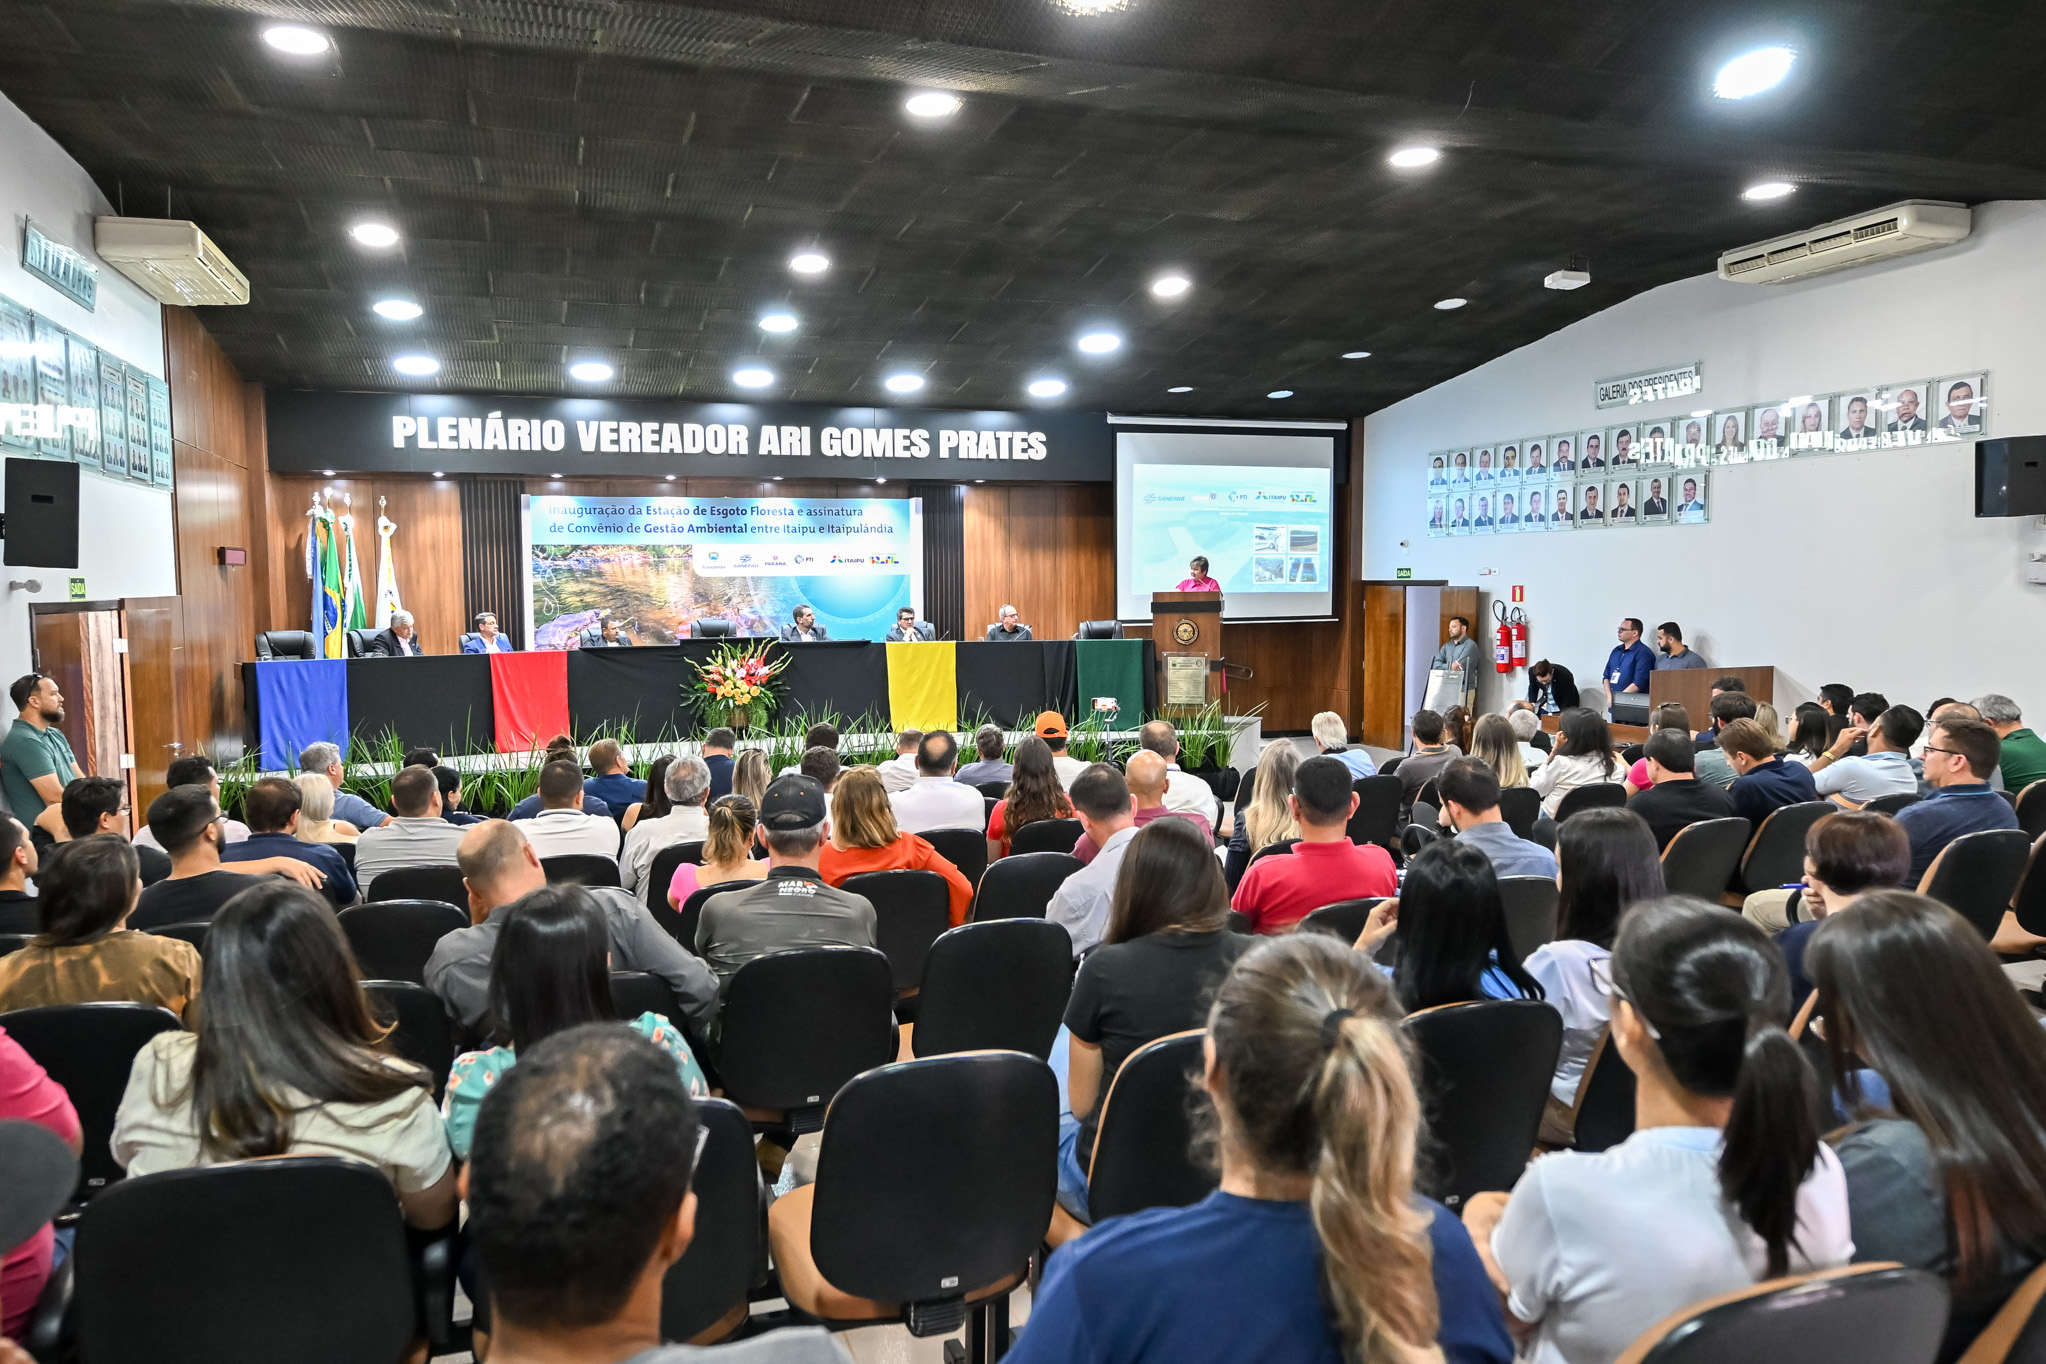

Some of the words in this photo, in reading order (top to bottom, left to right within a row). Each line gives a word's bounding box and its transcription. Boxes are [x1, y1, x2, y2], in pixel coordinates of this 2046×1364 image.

[1600, 383, 1628, 402] GALERIA
[392, 410, 565, 451] PLENÁRIO
[576, 420, 748, 454] VEREADOR
[759, 425, 810, 456] ARI
[820, 427, 930, 458] GOMES
[939, 430, 1046, 460] PRATES
[549, 505, 625, 518] Inauguração
[628, 505, 643, 515] da
[646, 506, 690, 518] Estação
[693, 506, 707, 516] de
[710, 506, 747, 518] Esgoto
[751, 506, 794, 516] Floresta
[797, 508, 804, 516] e
[806, 506, 863, 516] assinatura
[550, 523, 564, 533] de
[567, 522, 623, 533] Convênio
[626, 523, 640, 533] de
[644, 523, 684, 533] Gestão
[687, 523, 747, 533] Ambiental
[751, 525, 780, 533] entre
[783, 524, 815, 536] Itaipu
[828, 524, 893, 536] Itaipulândia
[71, 580, 85, 594] SAÍDA
